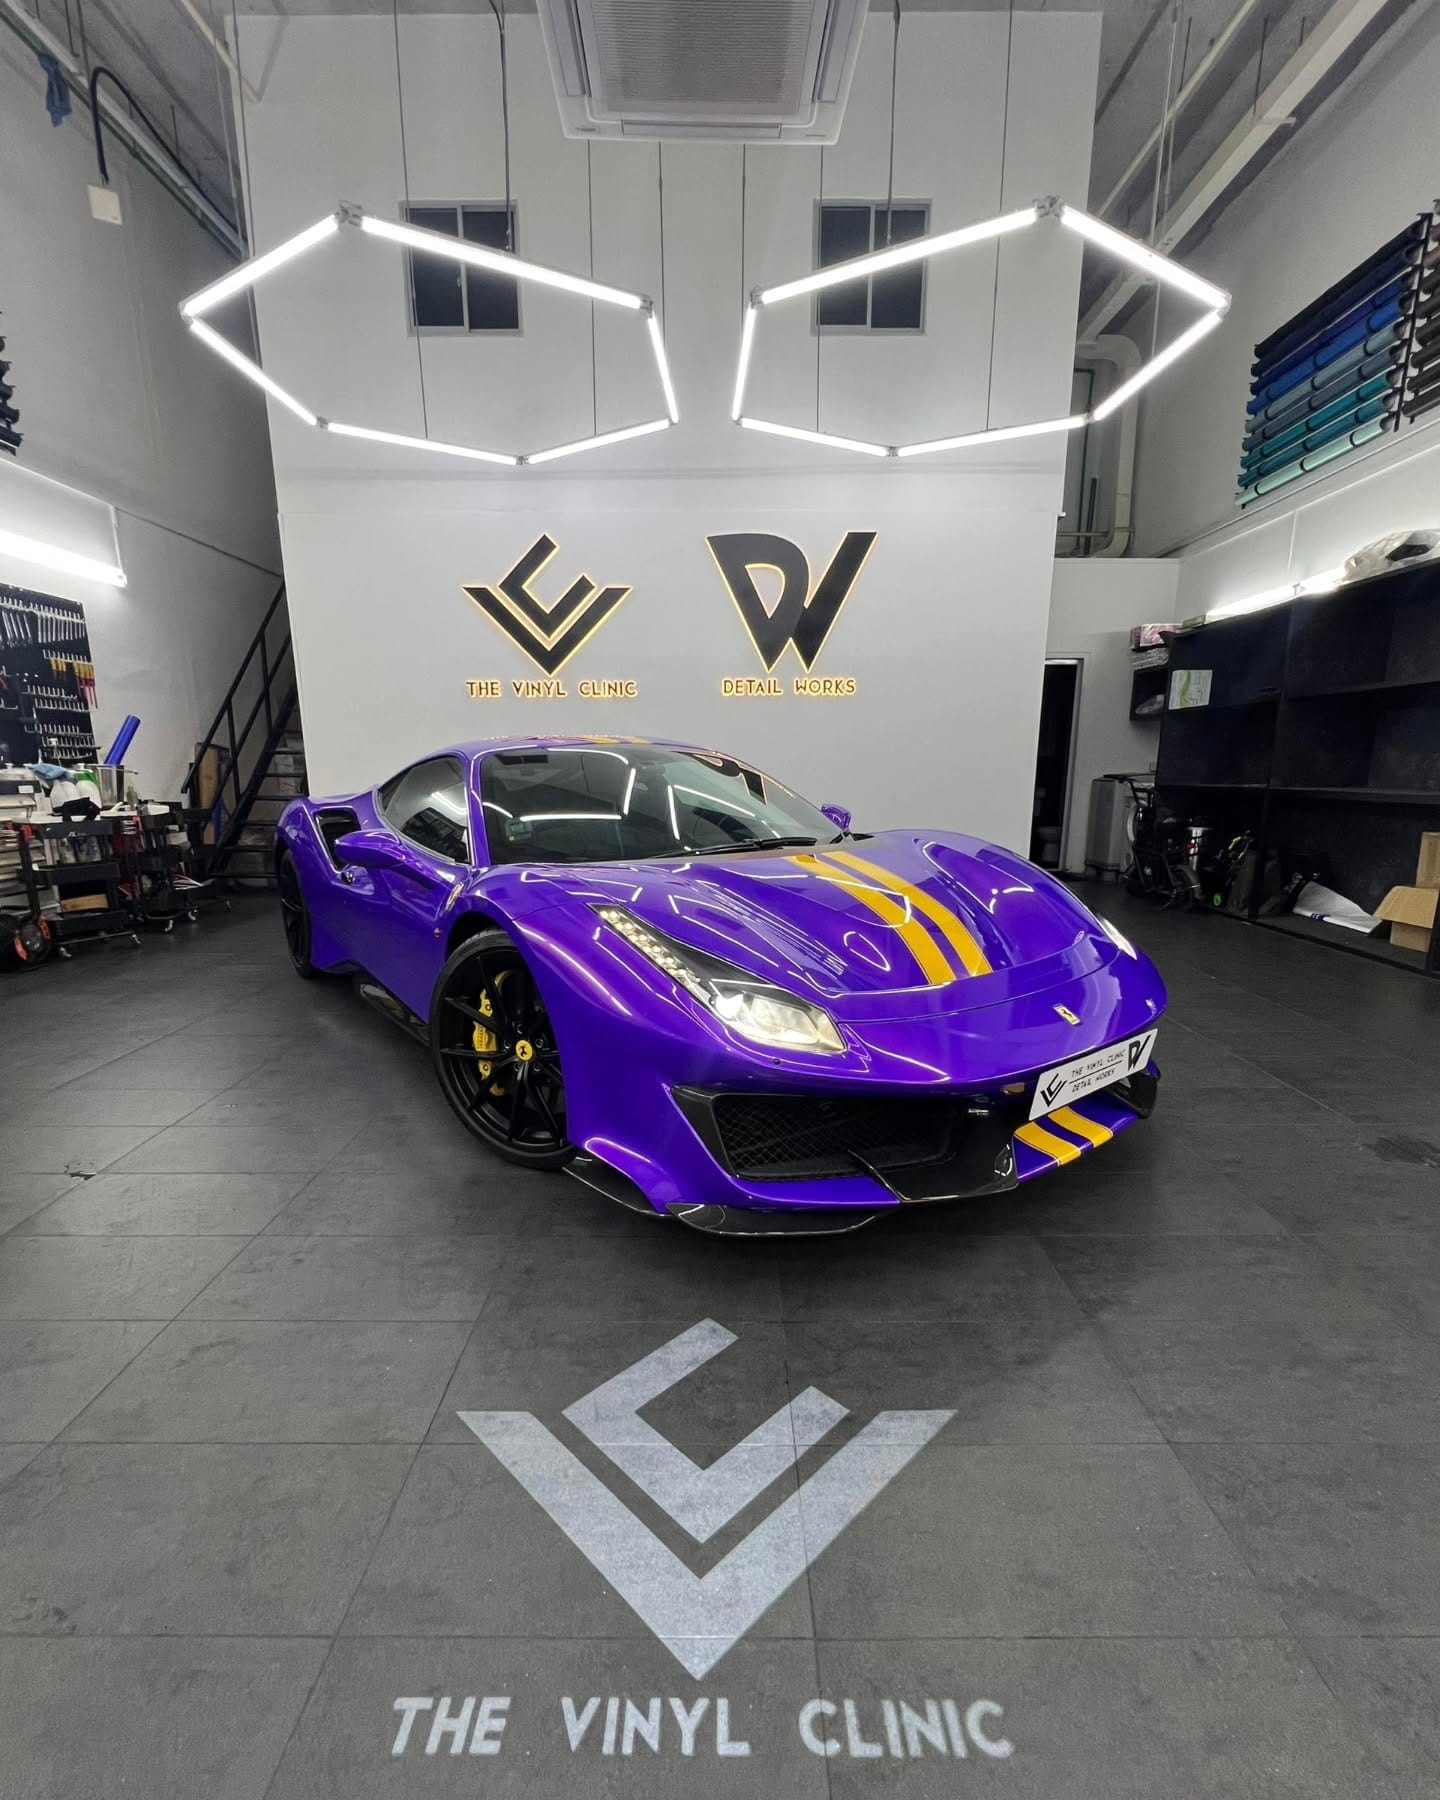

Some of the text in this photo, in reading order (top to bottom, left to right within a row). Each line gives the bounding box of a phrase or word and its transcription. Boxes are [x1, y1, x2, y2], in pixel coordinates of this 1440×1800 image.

[465, 680, 638, 697] THE VINYL CLINIC
[722, 678, 856, 695] DETAIL WORKS
[1071, 1066, 1083, 1078] THE
[1107, 1049, 1126, 1062] CLINIC
[1071, 1079, 1092, 1093] DETAIL
[391, 1696, 1015, 1760] THE VINYL CLINIC
